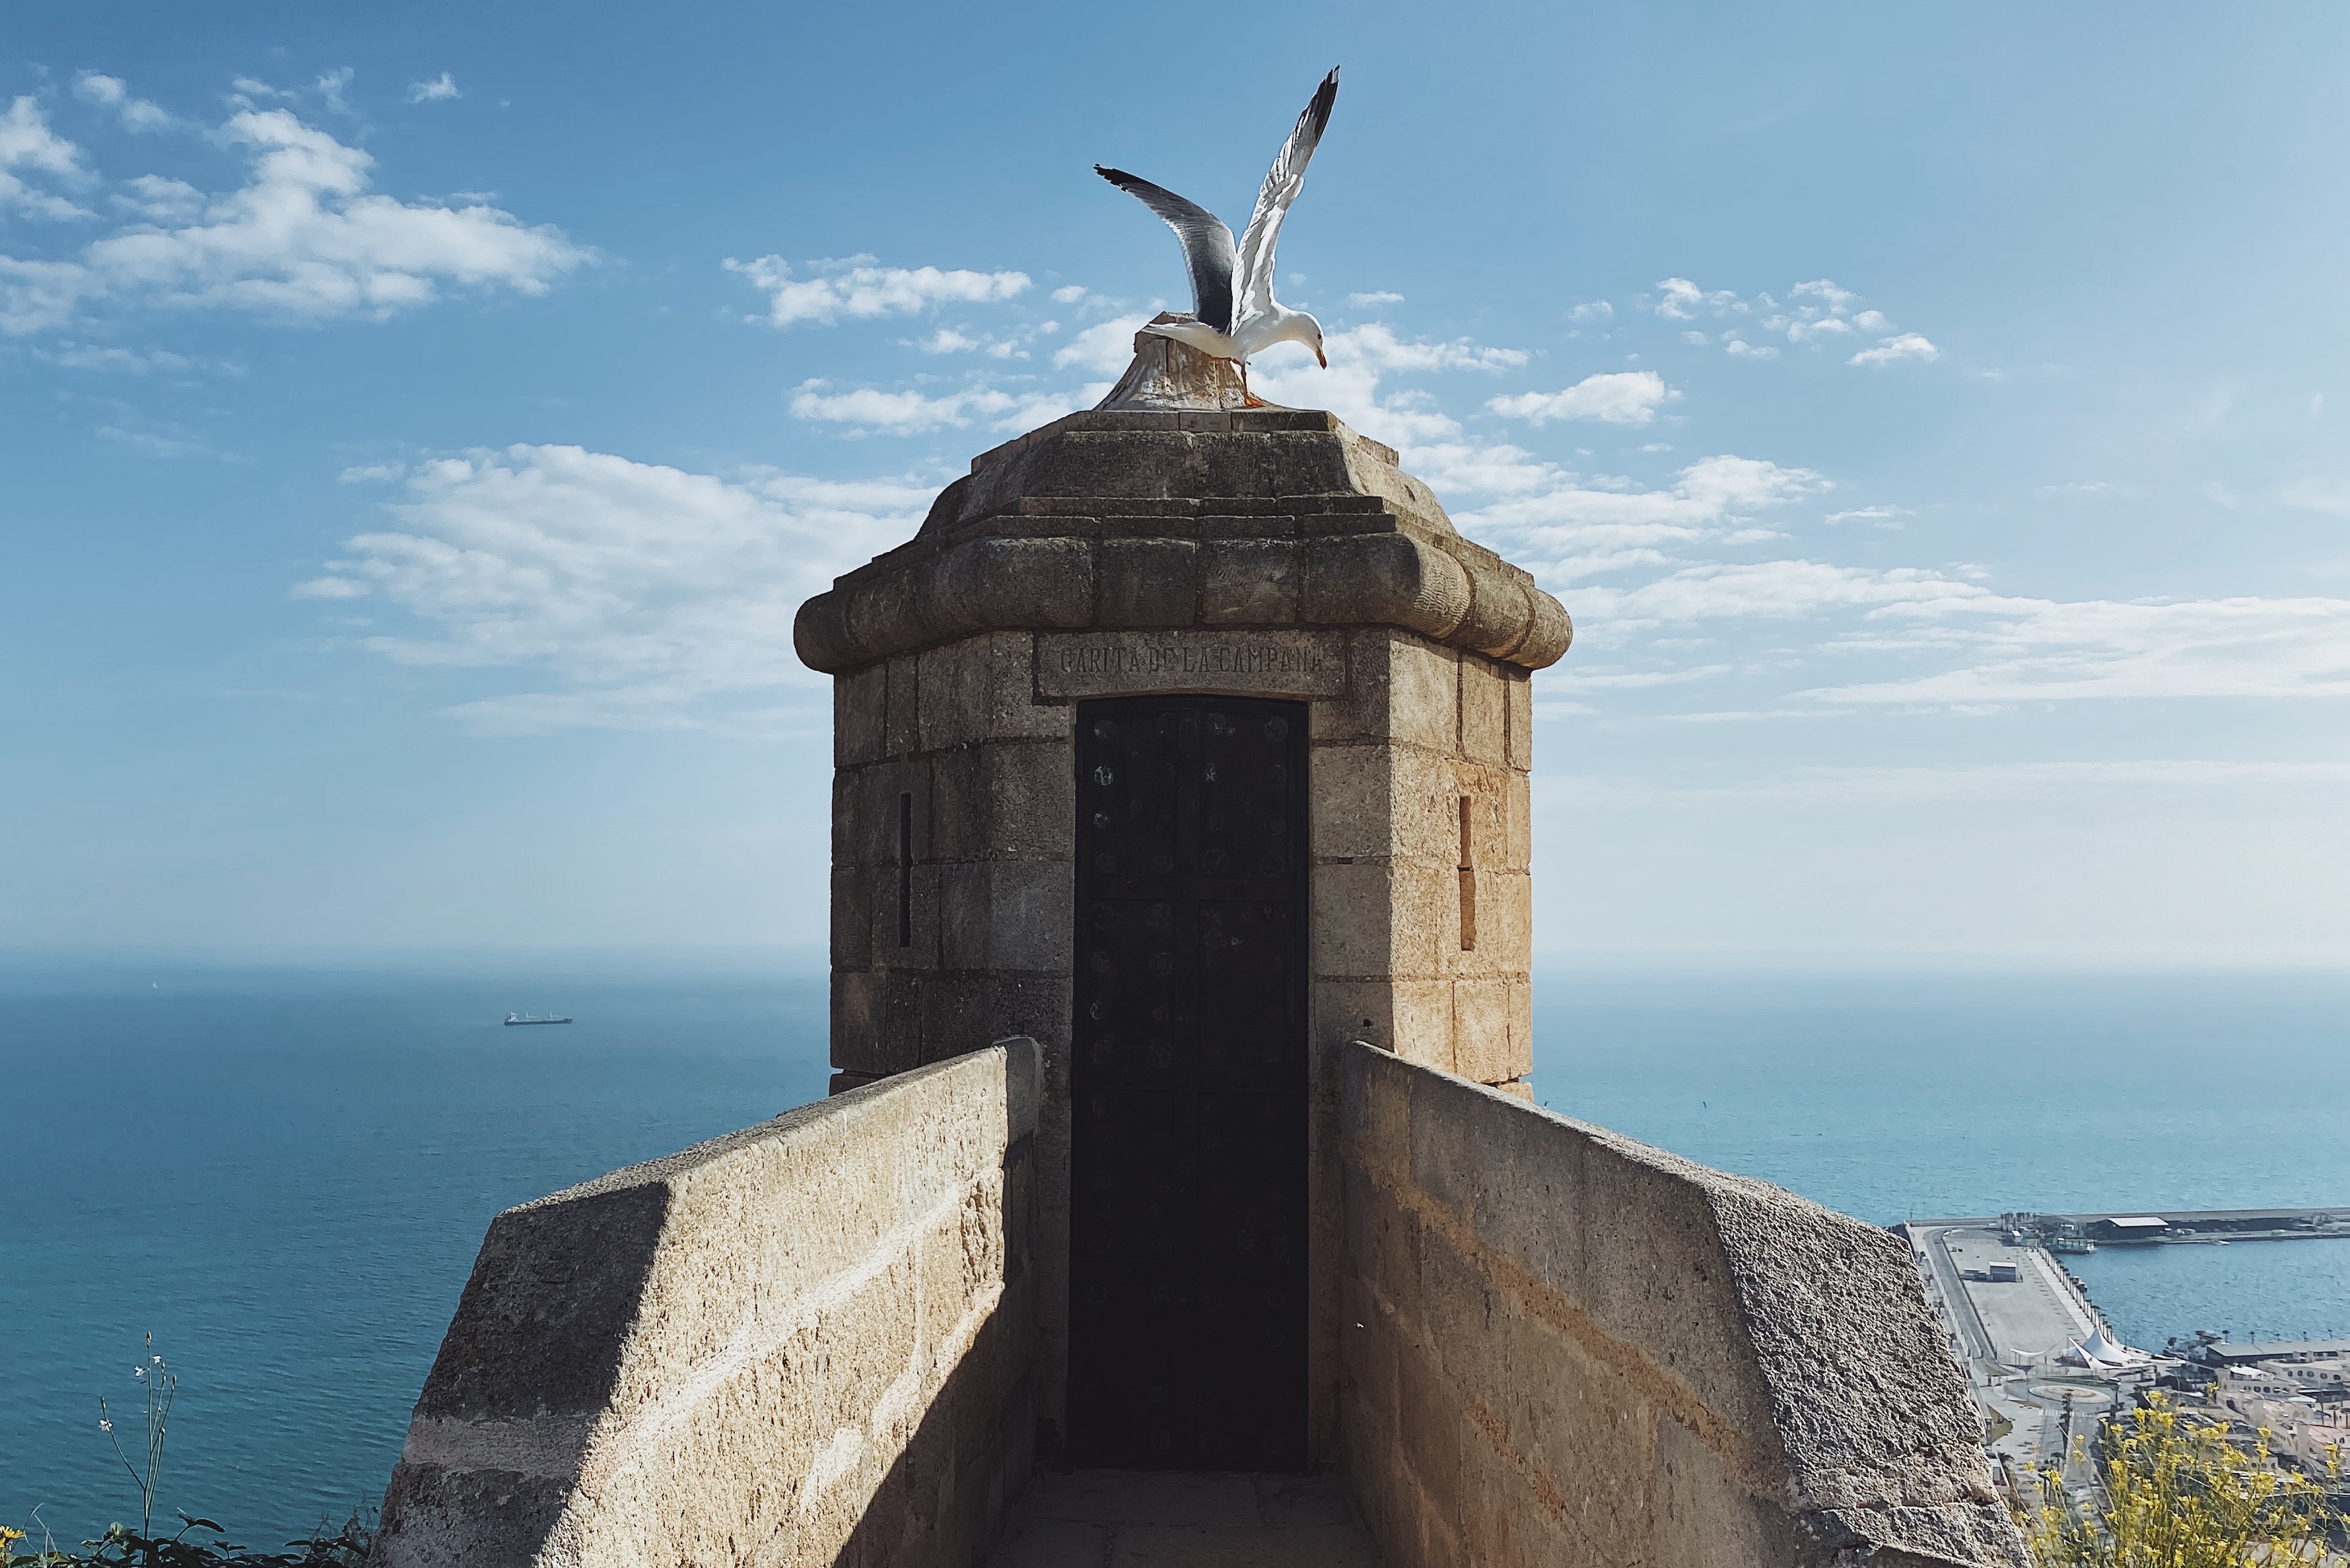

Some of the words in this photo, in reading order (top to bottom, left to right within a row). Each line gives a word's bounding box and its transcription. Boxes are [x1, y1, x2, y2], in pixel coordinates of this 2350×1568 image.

[1148, 646, 1174, 671] DE
[1182, 646, 1210, 672] LA
[1218, 646, 1323, 673] CAMPANA
